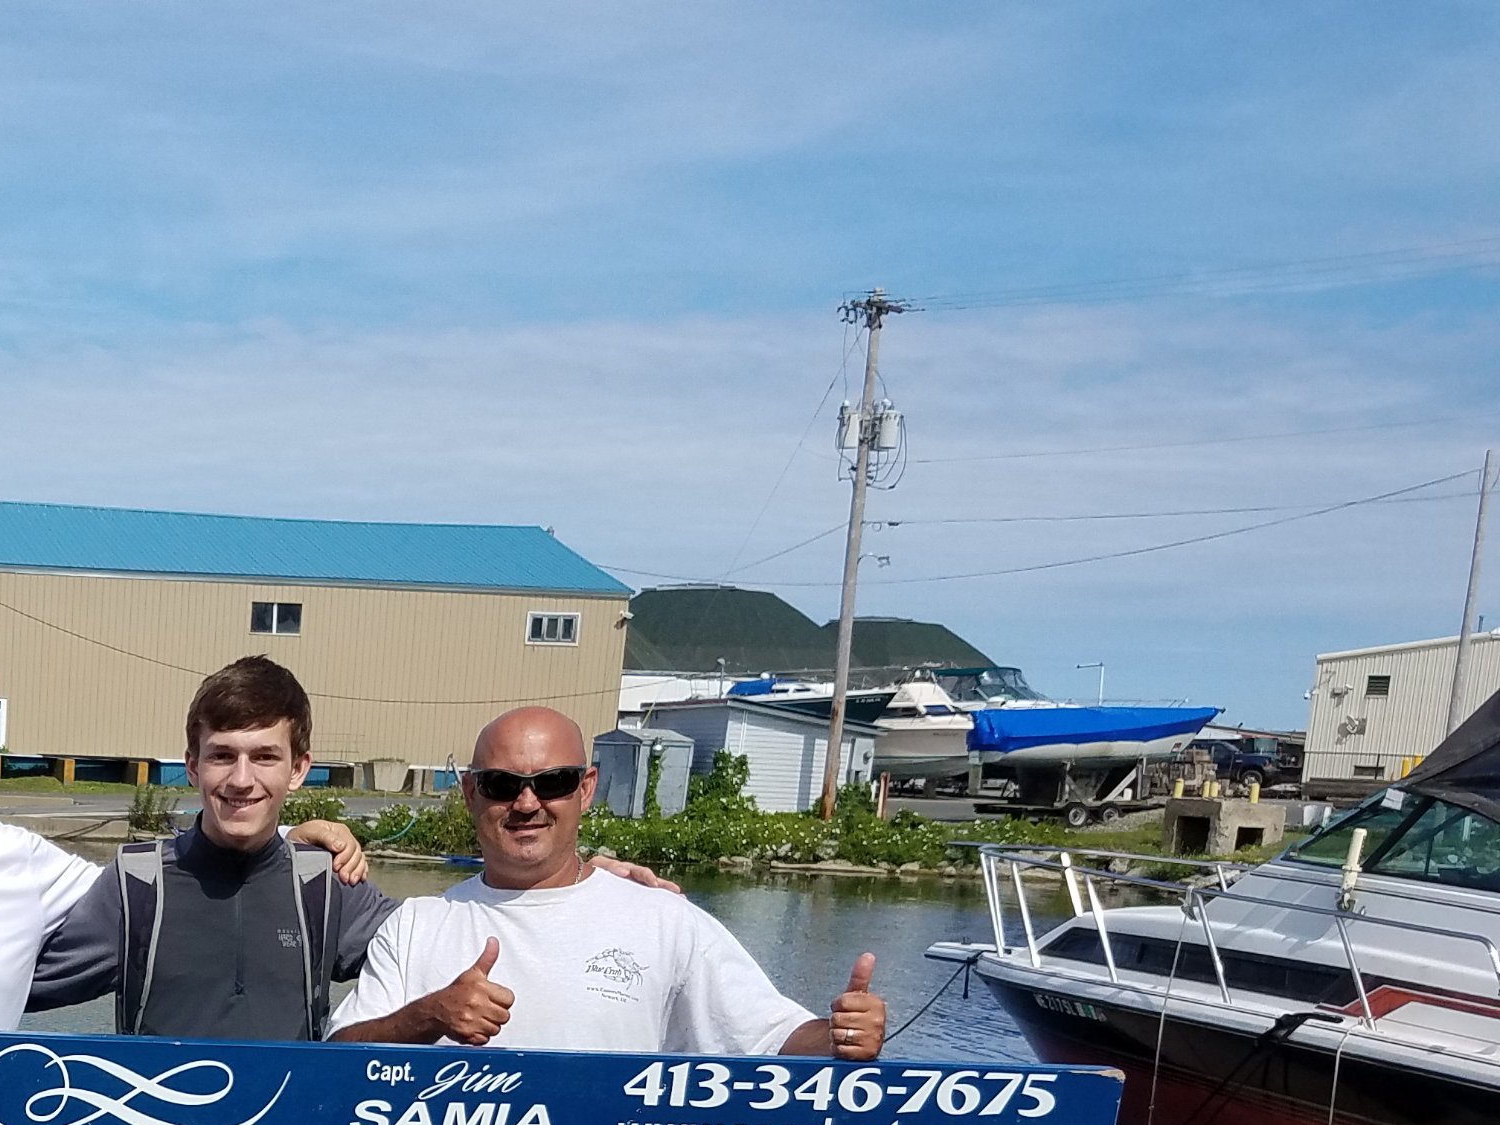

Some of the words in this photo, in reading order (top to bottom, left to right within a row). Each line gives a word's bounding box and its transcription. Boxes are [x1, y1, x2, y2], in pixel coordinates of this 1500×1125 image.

[367, 1060, 415, 1086] Capt.
[418, 1060, 523, 1100] Jim
[623, 1061, 1058, 1119] 413-346-7675
